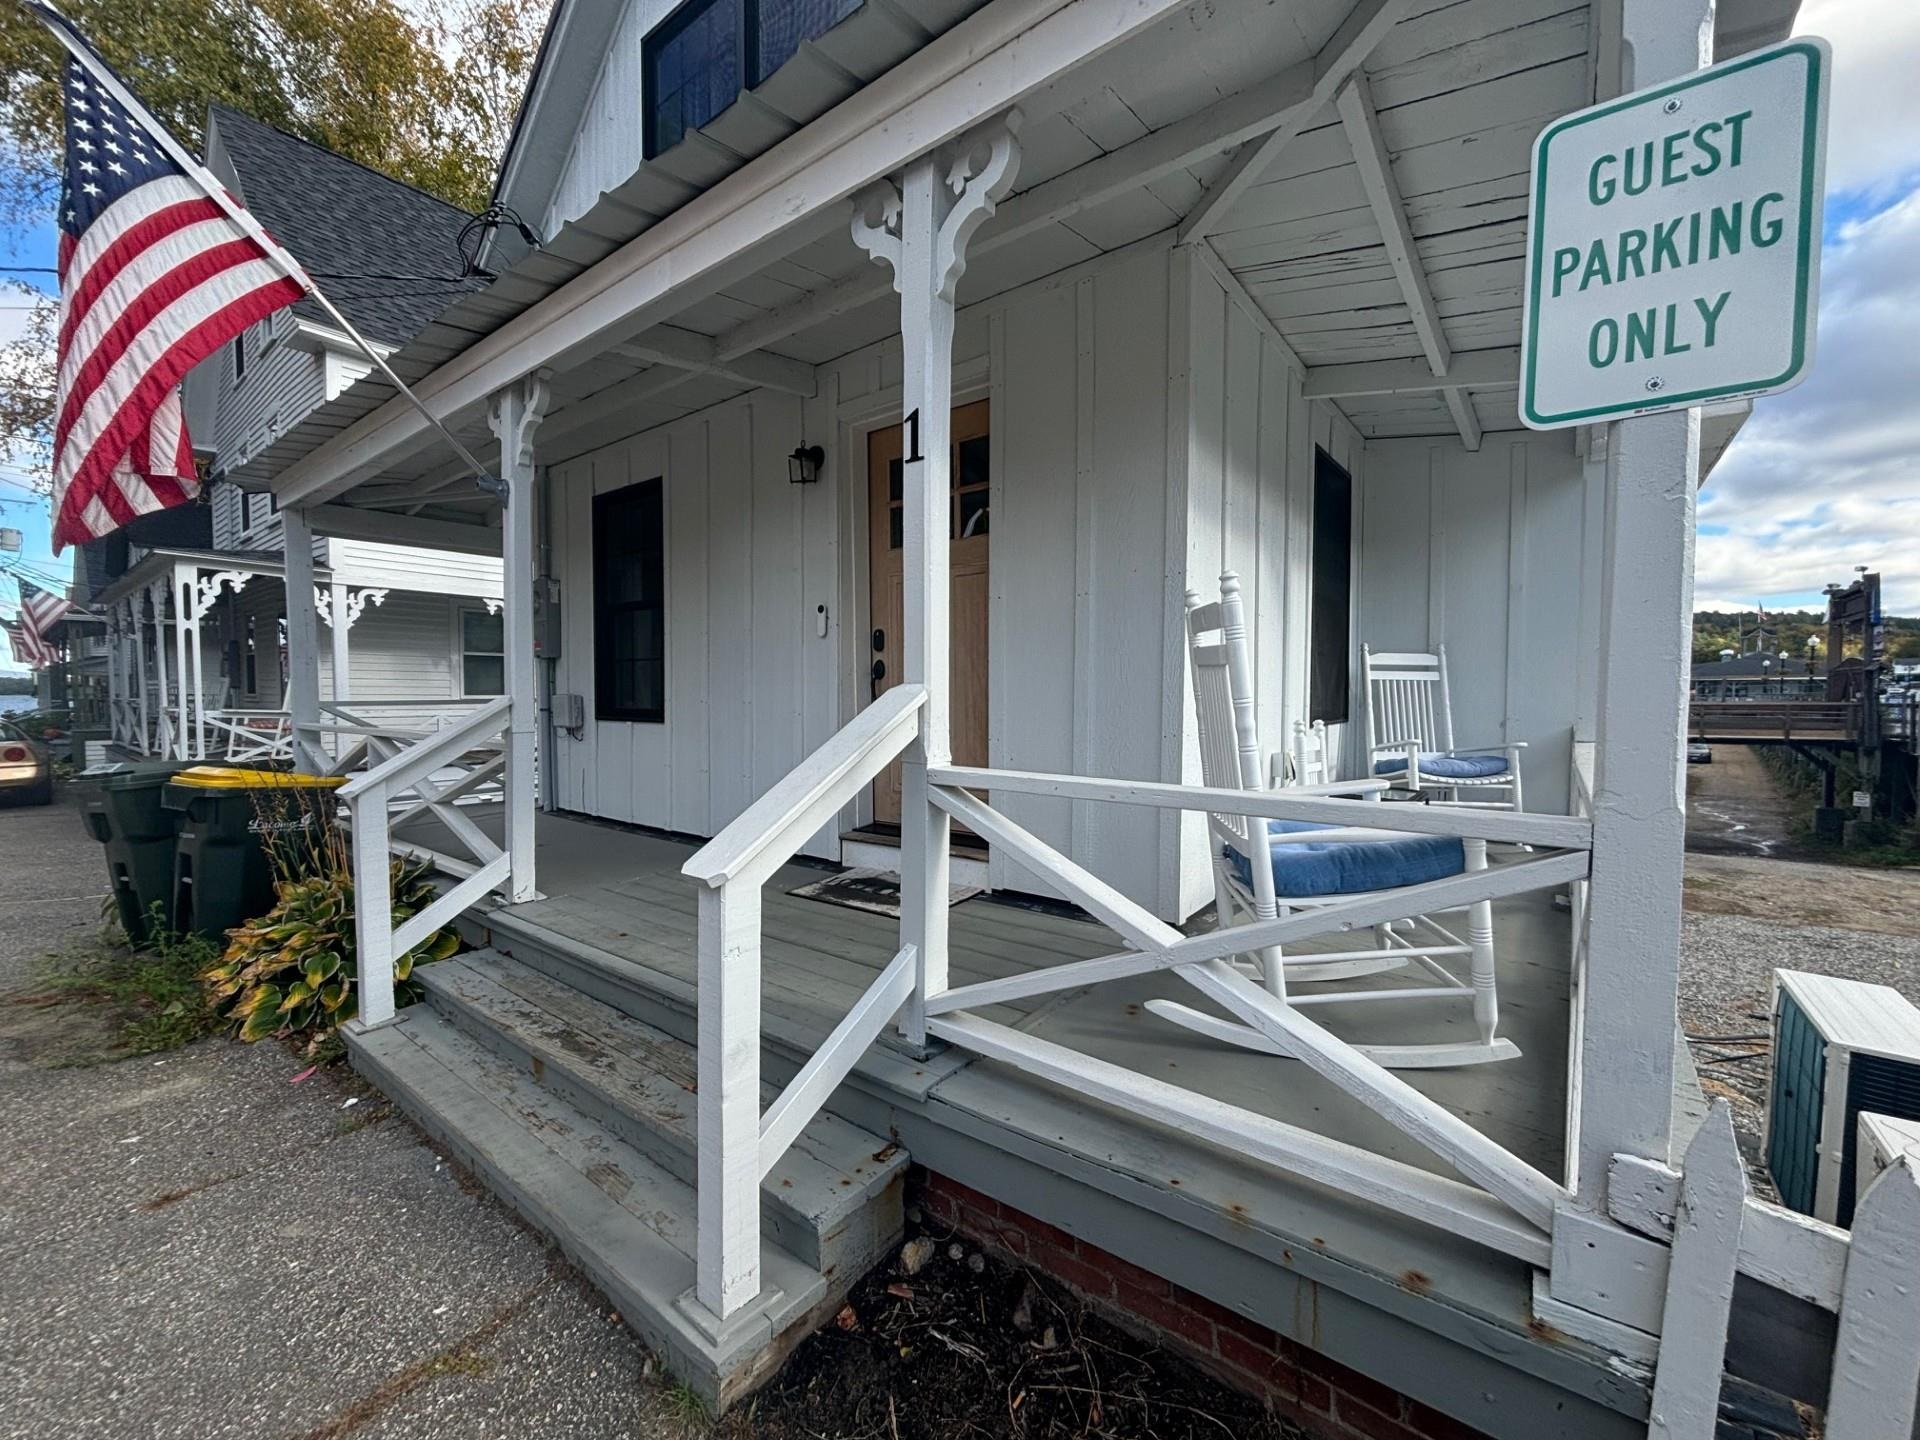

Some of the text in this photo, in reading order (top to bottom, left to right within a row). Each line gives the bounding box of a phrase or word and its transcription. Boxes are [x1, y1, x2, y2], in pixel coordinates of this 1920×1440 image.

[1588, 110, 1752, 206] GUEST
[1552, 192, 1784, 298] PARKING
[1588, 291, 1732, 368] ONLY
[904, 407, 925, 464] 1
